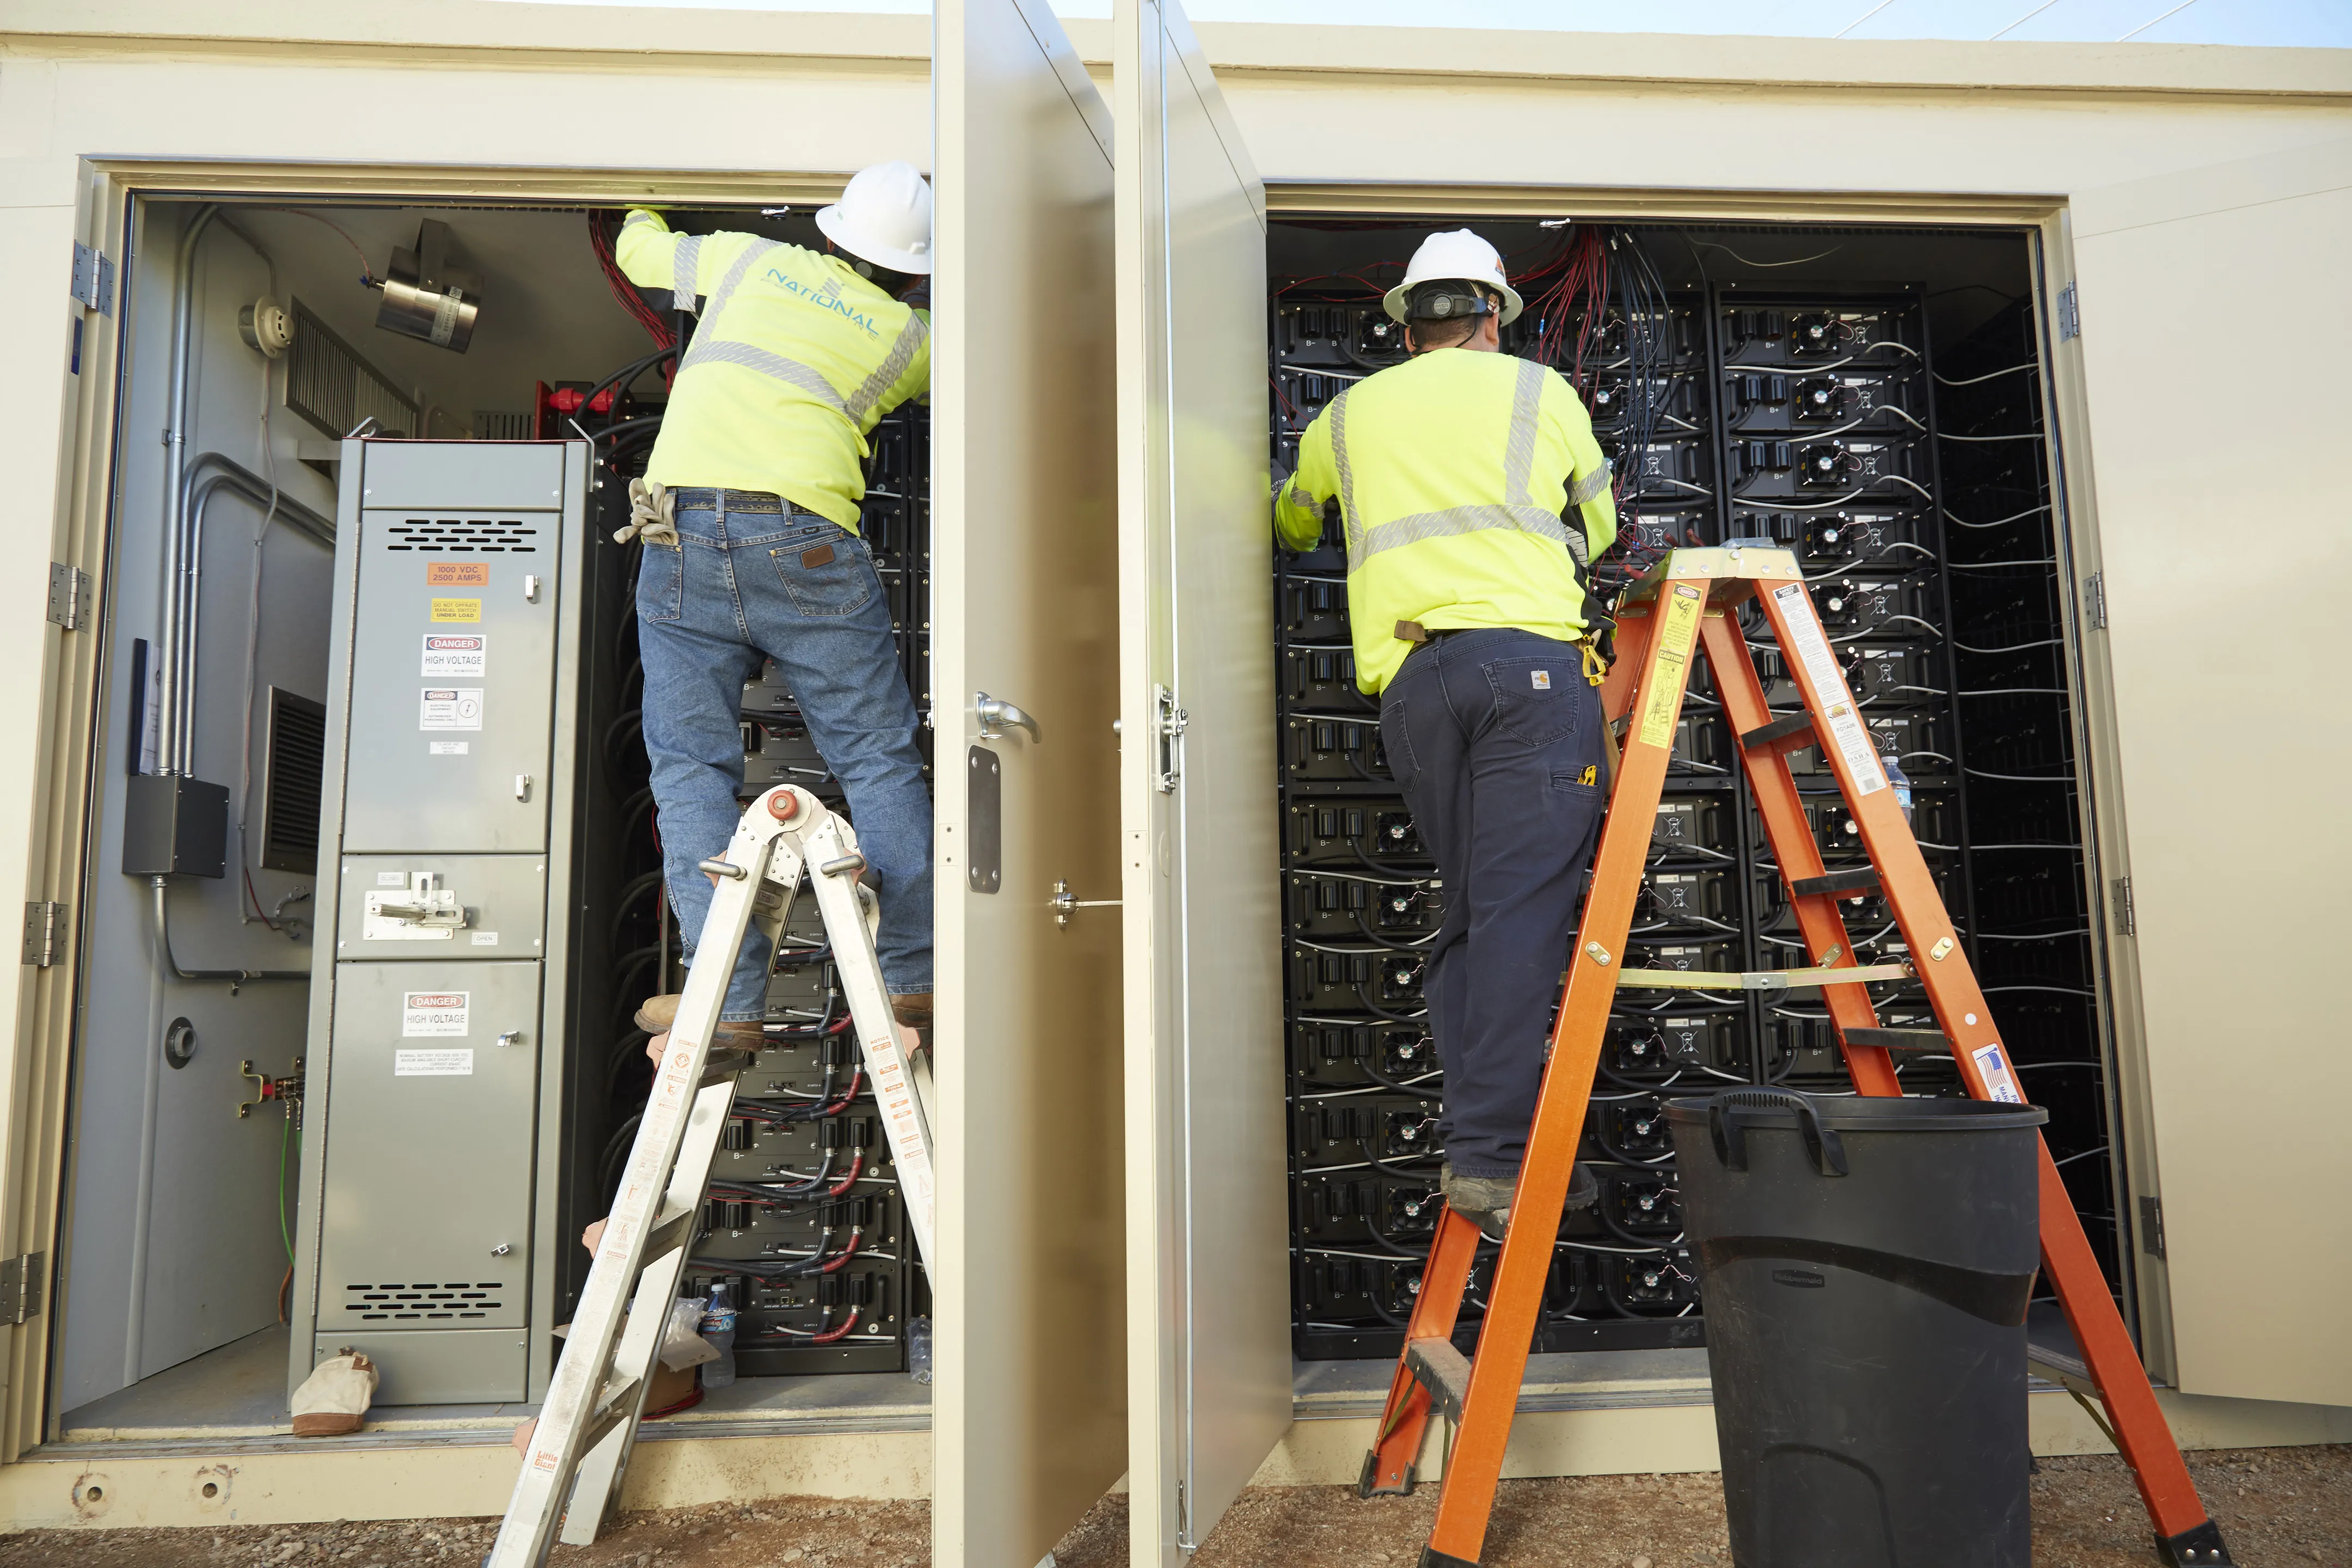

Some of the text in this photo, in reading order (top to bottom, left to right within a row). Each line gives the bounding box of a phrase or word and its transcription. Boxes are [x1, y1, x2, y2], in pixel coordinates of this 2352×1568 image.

[767, 268, 879, 335] NATIONAL
[1779, 586, 1794, 595] SAFETY
[425, 656, 482, 664] HIGH VOLTAGE
[1659, 651, 1684, 664] CAUTION
[407, 1014, 465, 1023] HIGH VOLTAGE
[870, 1035, 890, 1044] NOTICE
[1775, 1274, 1822, 1284] Rubbermaid
[537, 1450, 558, 1462] Little
[535, 1459, 555, 1470] Giant
